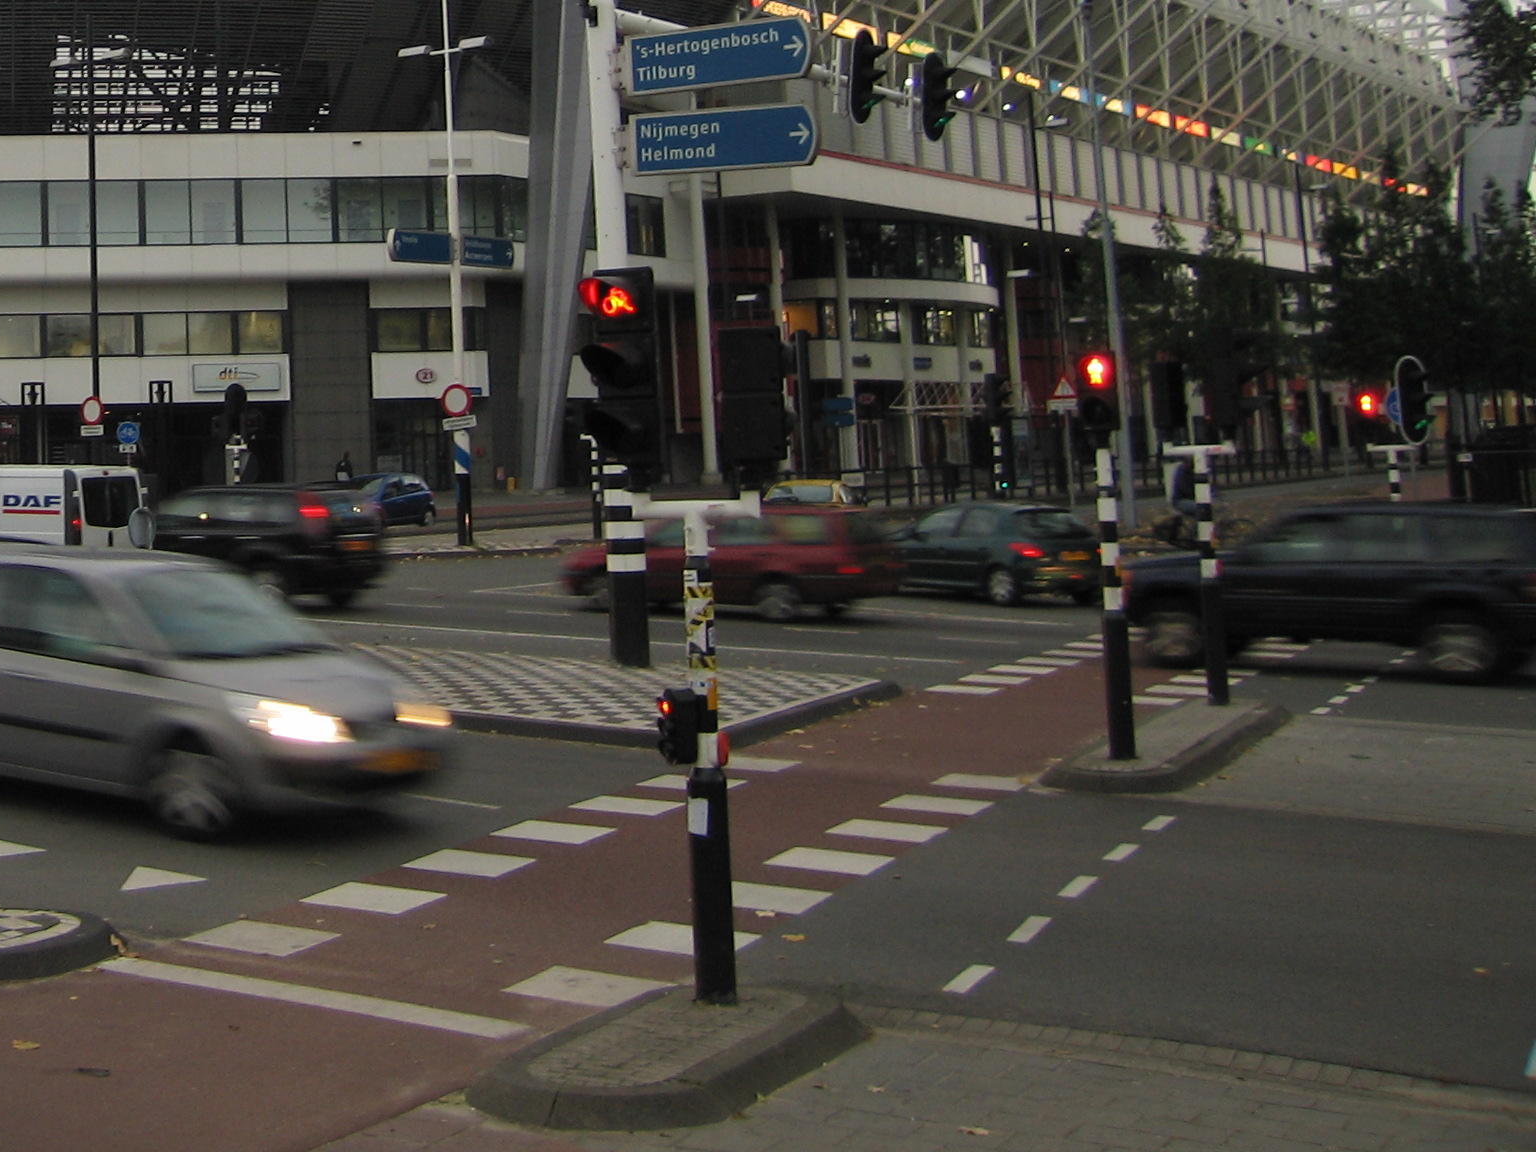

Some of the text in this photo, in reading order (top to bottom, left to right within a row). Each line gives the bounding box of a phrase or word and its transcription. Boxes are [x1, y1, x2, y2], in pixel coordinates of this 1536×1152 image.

[636, 28, 779, 58] 's-Hertogenbosch
[636, 64, 696, 82] Tilburg
[640, 122, 720, 142] Nijmegen
[641, 144, 716, 162] Helmond
[2, 494, 63, 507] DAF
